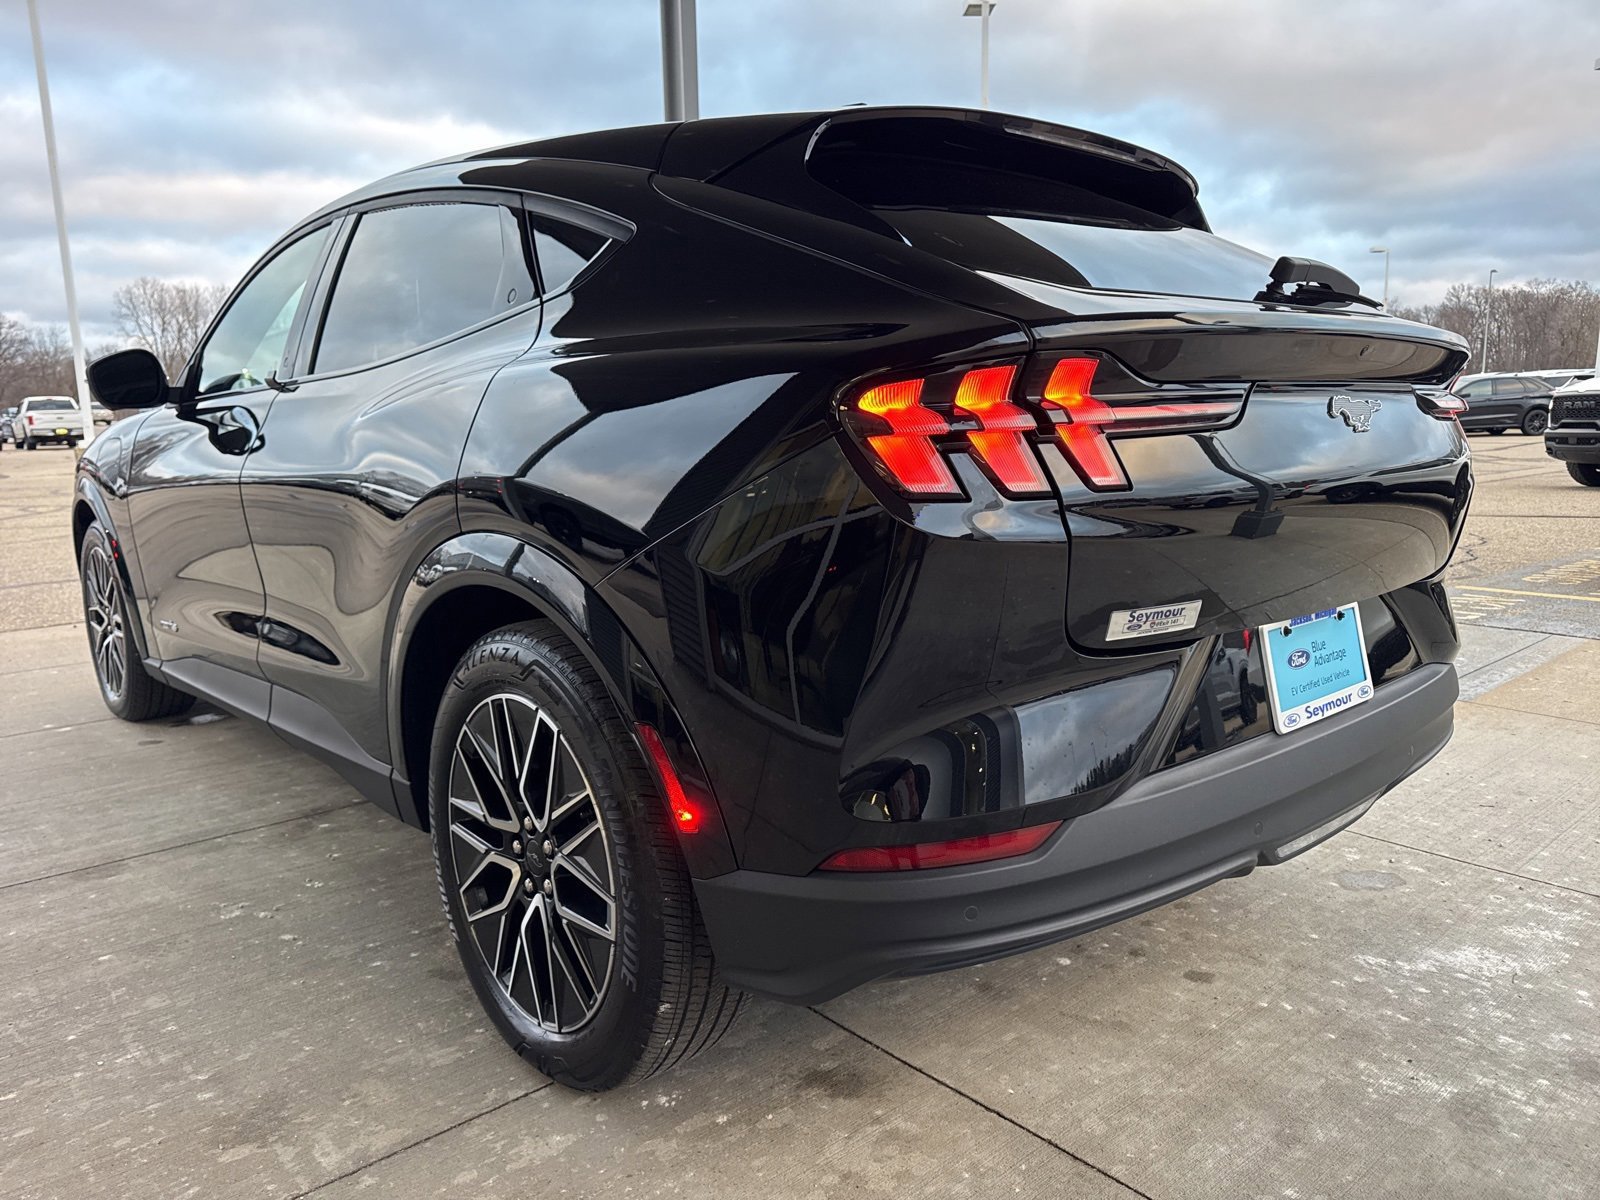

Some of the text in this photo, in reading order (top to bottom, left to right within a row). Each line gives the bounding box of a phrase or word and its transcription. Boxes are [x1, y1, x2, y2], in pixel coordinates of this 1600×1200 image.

[1563, 400, 1595, 409] RAM
[1128, 607, 1186, 624] Seymour
[1311, 639, 1327, 653] Blue
[463, 646, 520, 675] ALENZA
[1291, 651, 1307, 667] Ford
[1314, 648, 1347, 667] Advantage
[1291, 668, 1350, 696] EV Certified Used Vehicle
[1305, 692, 1353, 719] Seymour
